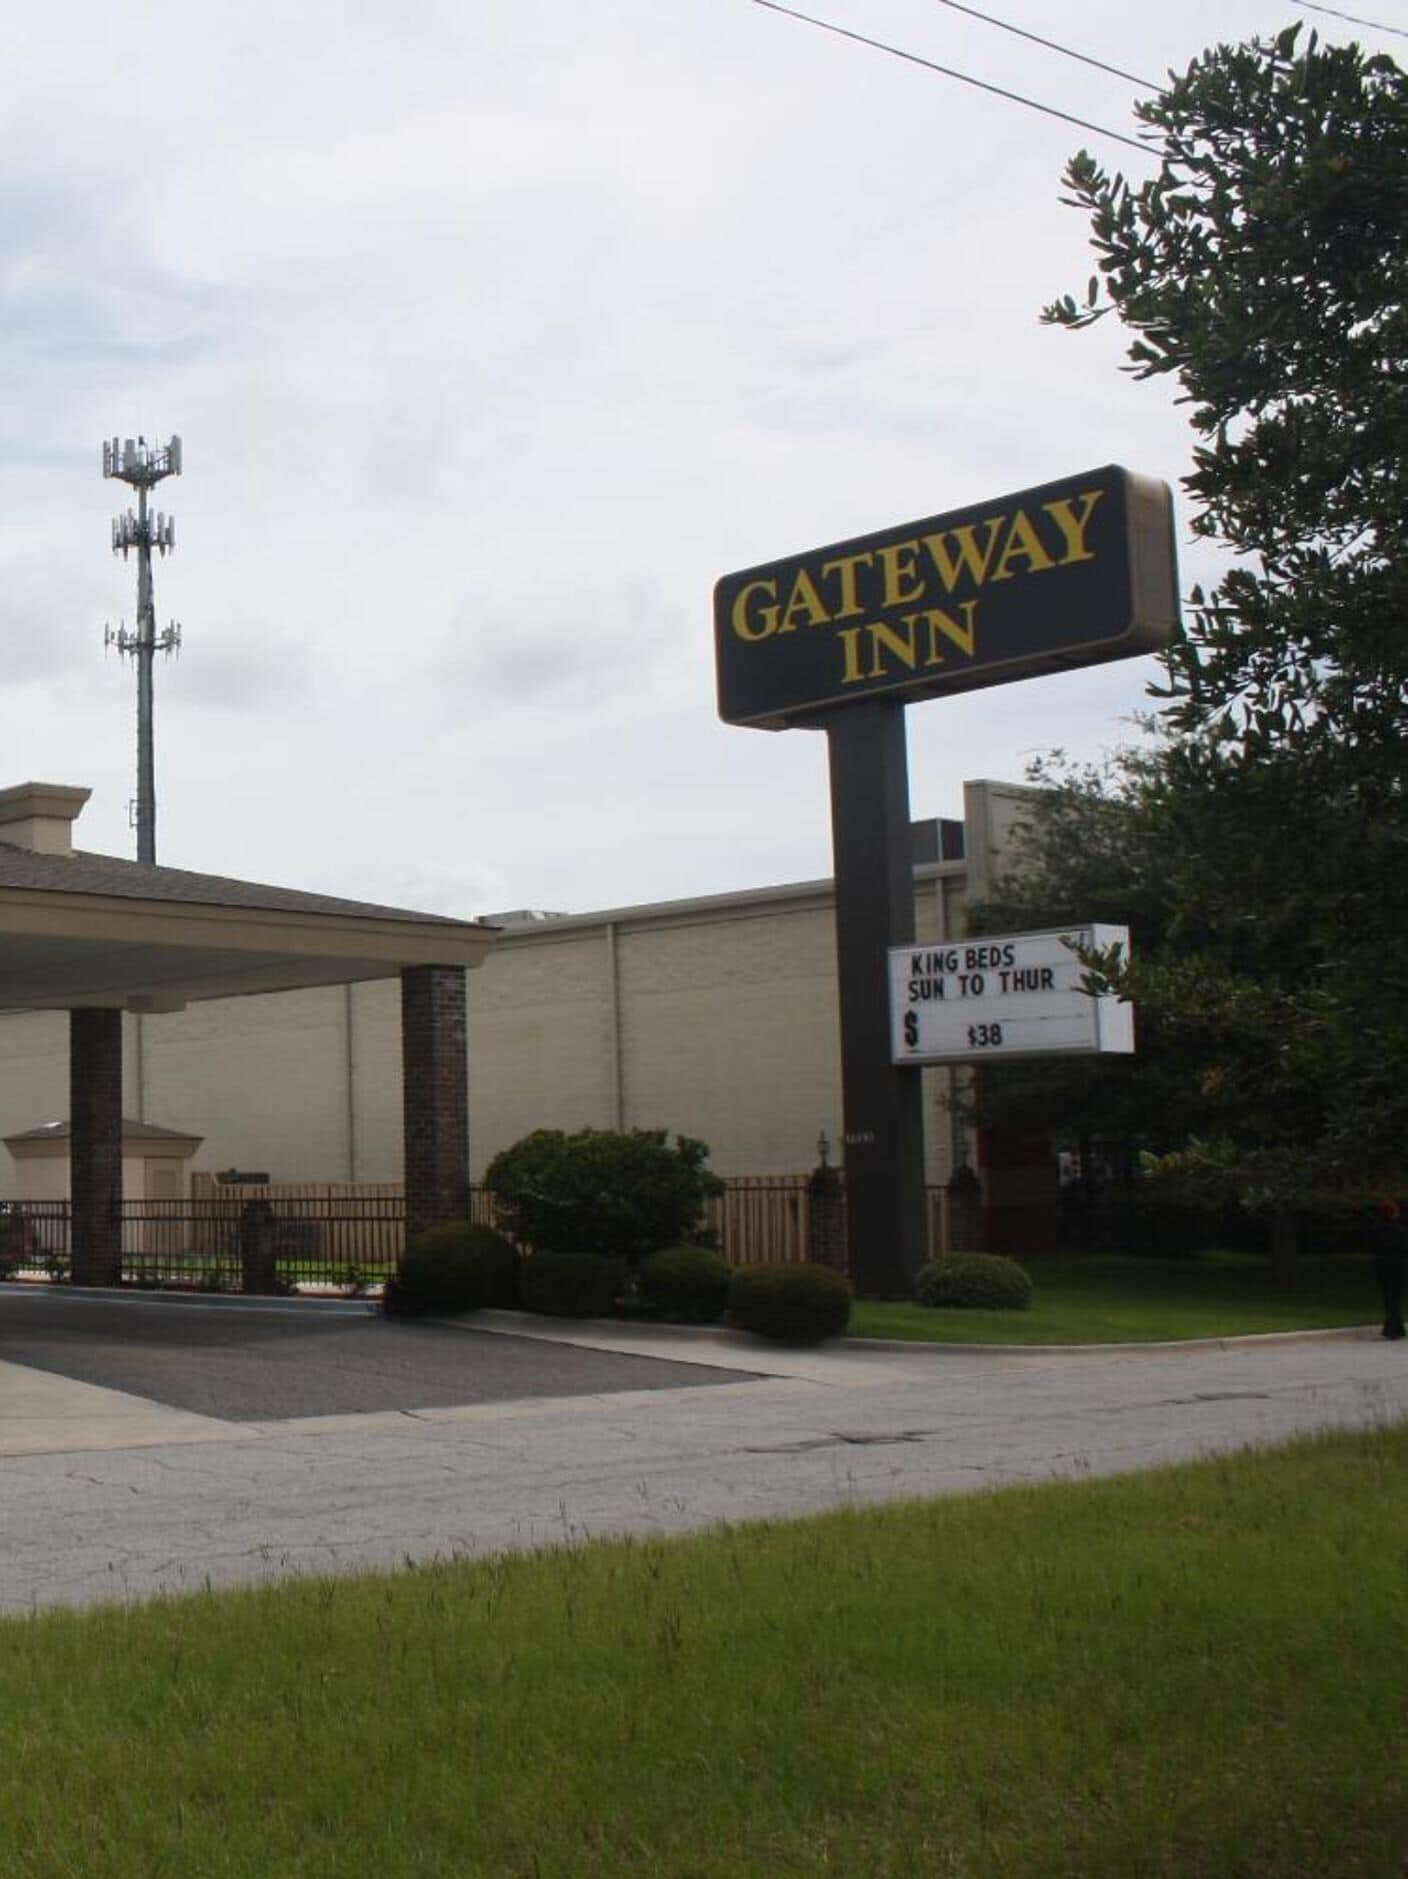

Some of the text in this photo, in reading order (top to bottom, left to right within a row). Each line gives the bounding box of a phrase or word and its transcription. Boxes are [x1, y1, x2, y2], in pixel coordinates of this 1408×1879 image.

[731, 490, 1103, 642] GATEWAY
[838, 601, 977, 684] INN
[911, 945, 1015, 976] KING BEDS
[908, 968, 1053, 1002] SUN TO THUR
[967, 1023, 1002, 1047] $38
